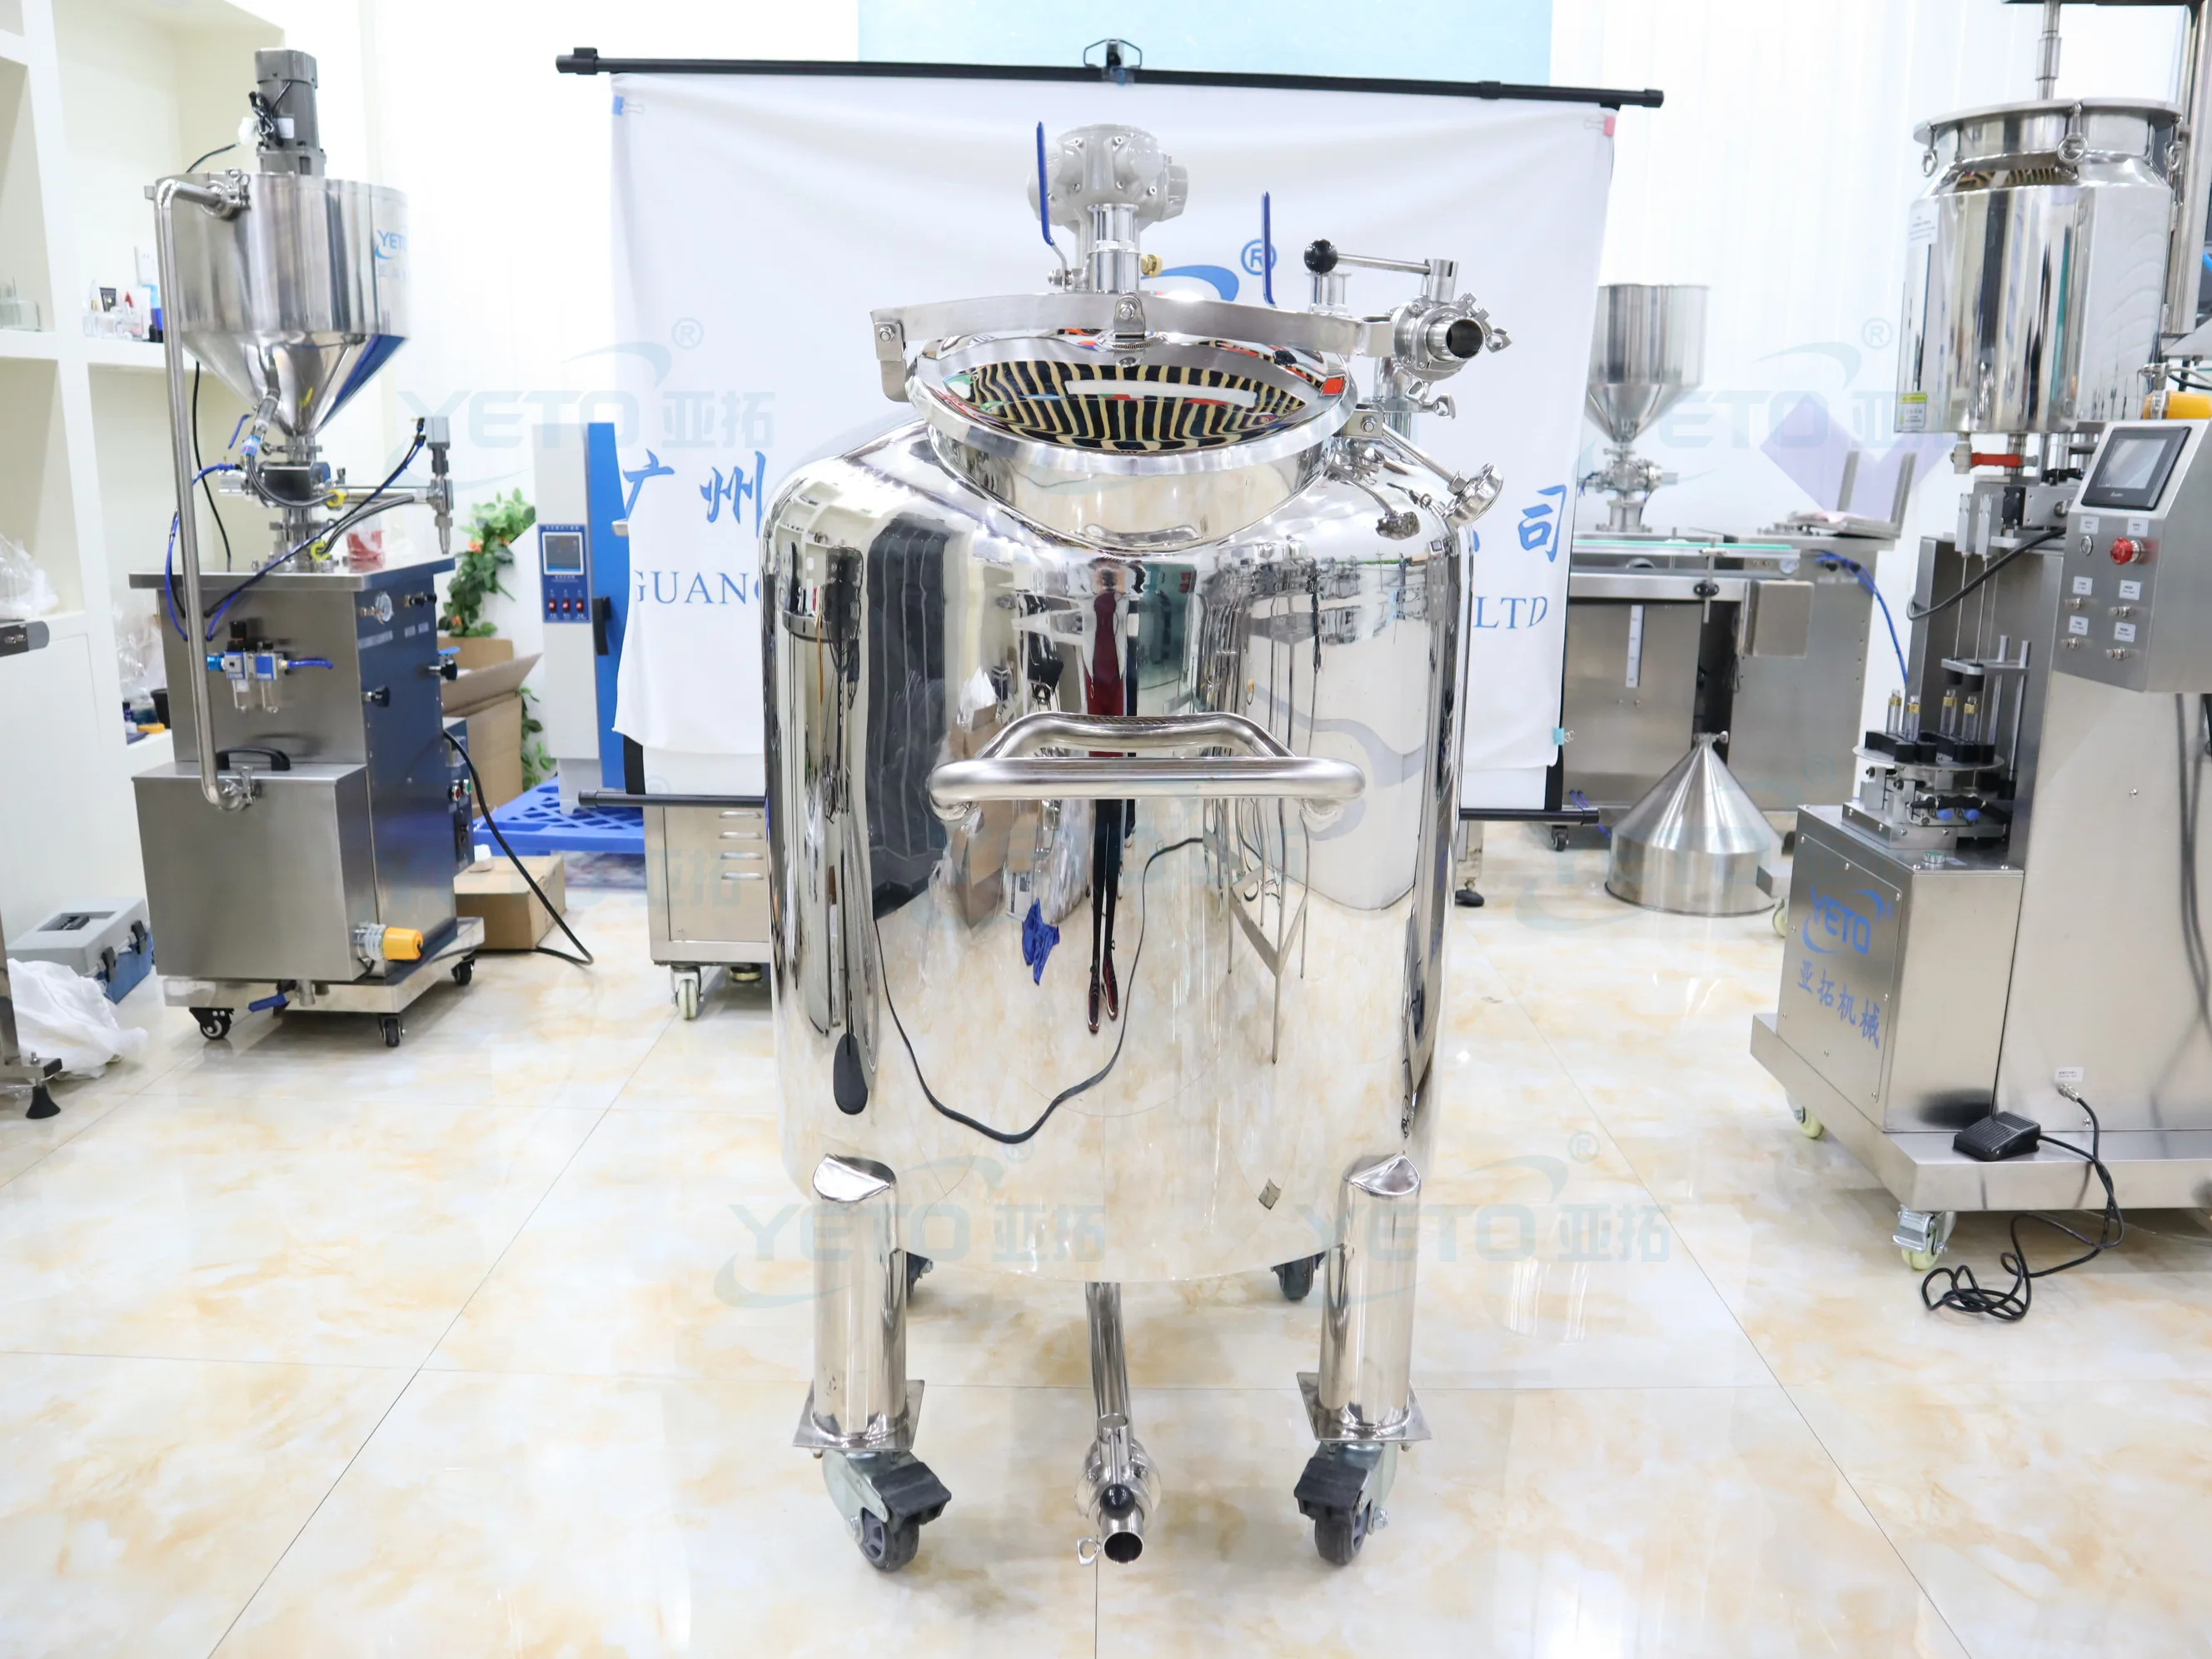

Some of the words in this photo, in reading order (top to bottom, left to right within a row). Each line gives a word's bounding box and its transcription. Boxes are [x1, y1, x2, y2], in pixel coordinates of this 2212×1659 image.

[622, 447, 766, 539] 广州
[1473, 595, 1548, 630] LTD
[1810, 884, 1872, 955] YETO
[1796, 959, 1881, 1049] 亚拓机械
